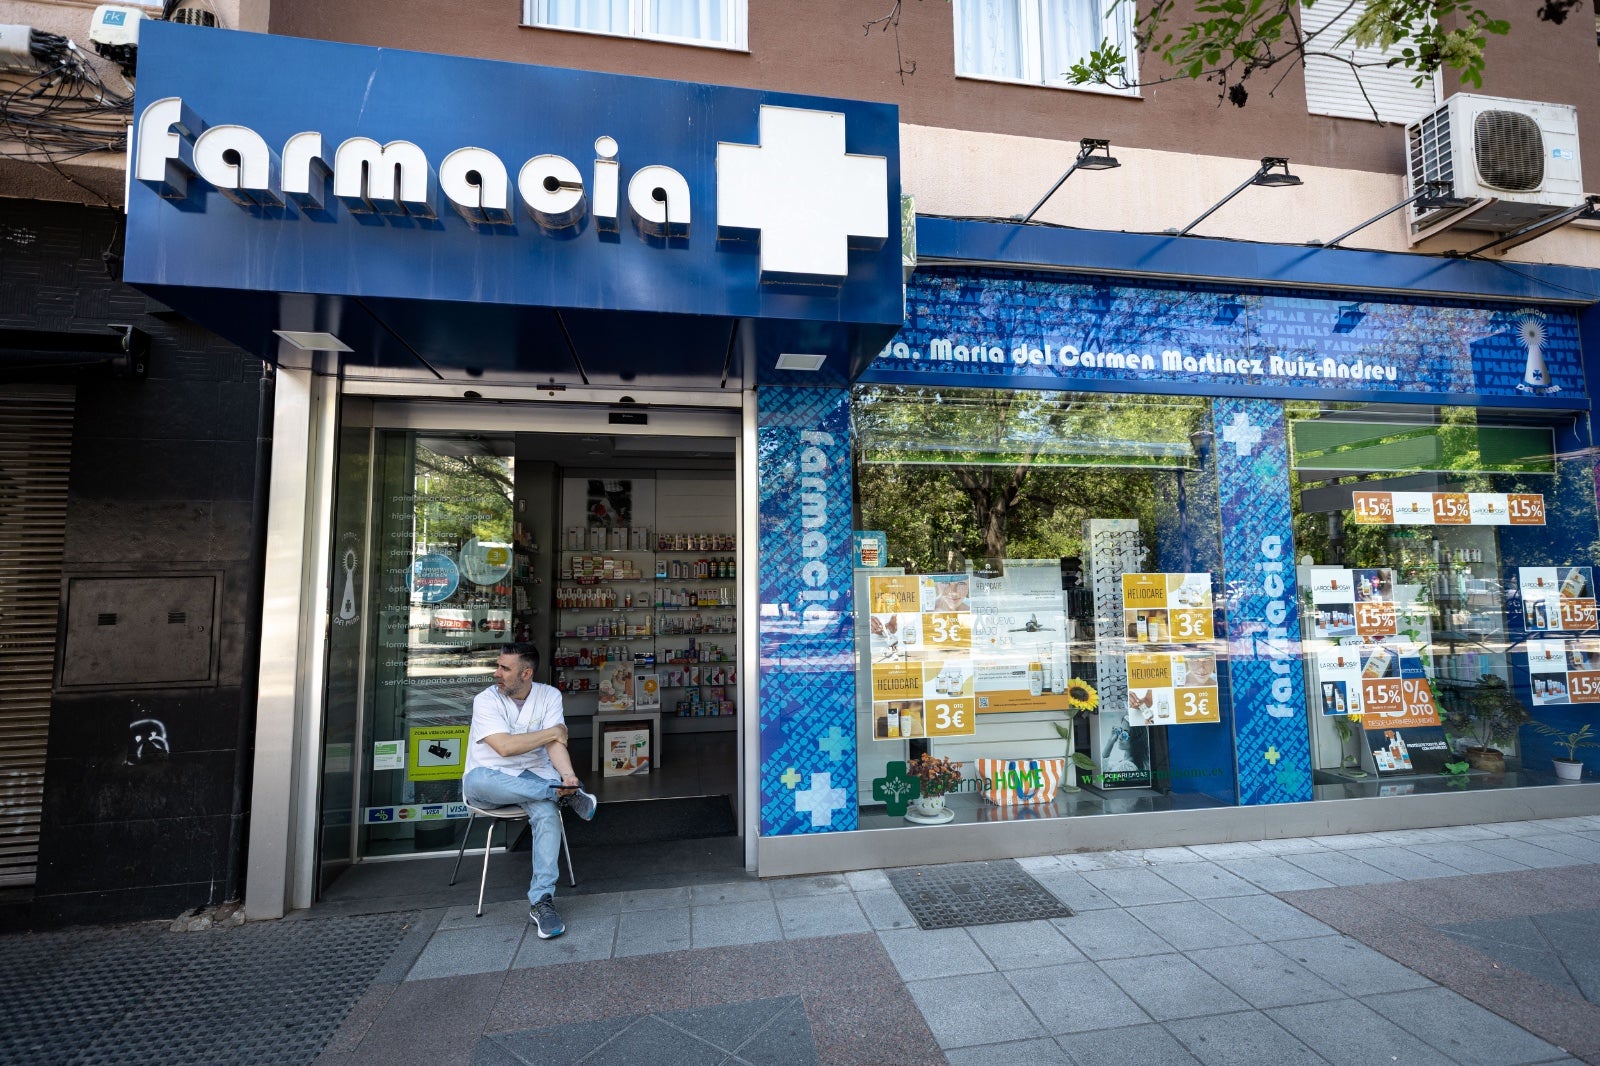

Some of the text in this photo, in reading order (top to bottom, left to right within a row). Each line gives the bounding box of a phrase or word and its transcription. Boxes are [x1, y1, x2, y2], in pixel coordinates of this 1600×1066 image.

[136, 96, 690, 228] farmacia
[930, 338, 1004, 363] María
[1012, 343, 1052, 365] del
[1059, 345, 1155, 369] Carmen
[1163, 350, 1264, 375] Martínez
[1270, 356, 1397, 381] Ruiz-Andreu
[1357, 497, 1392, 516] 15%
[1435, 498, 1469, 517] 15%
[1510, 499, 1543, 517] 15%
[800, 430, 839, 634] farmacia
[1127, 588, 1164, 600] HELIOCARE
[1359, 608, 1393, 627] 15%
[1564, 604, 1595, 622] 15%
[932, 616, 961, 643] 3€
[1178, 612, 1205, 637] 3€
[1255, 535, 1294, 717] farmacia
[384, 678, 416, 687] servicio
[417, 677, 448, 688] reparto
[457, 675, 493, 684] domicilio
[1131, 667, 1169, 680] HELIOCARE
[877, 677, 919, 691] HELIOCARE
[1366, 684, 1401, 704] 15%
[1183, 692, 1210, 717] 3€
[1410, 703, 1433, 716] DTO
[935, 703, 965, 729] 3€
[1368, 719, 1387, 727] DESDE
[995, 768, 1044, 791] HOME
[450, 805, 468, 813] VISA
